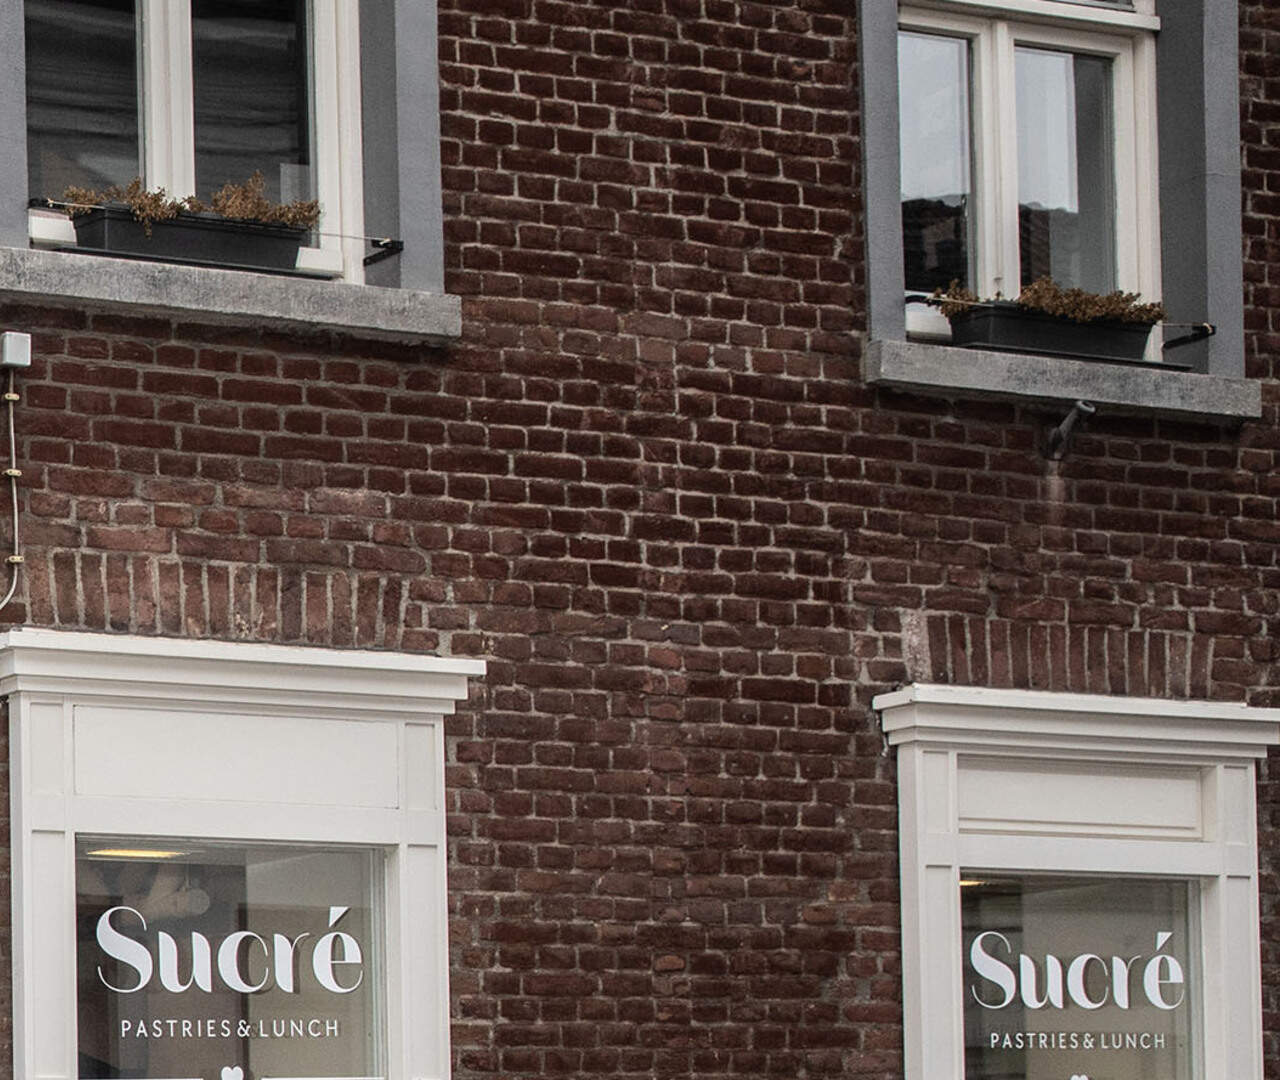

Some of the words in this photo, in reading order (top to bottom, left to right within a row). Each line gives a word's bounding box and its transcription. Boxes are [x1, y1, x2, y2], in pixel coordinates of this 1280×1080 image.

[95, 905, 365, 994] Sucré
[969, 930, 1186, 1011] Sucré
[120, 1018, 231, 1039] PASTRIES
[236, 1019, 252, 1039] &
[258, 1018, 340, 1039] LUNCH
[990, 1032, 1079, 1050] PASTRIES
[1083, 1033, 1096, 1050] &
[1100, 1032, 1166, 1050] LUNCH
